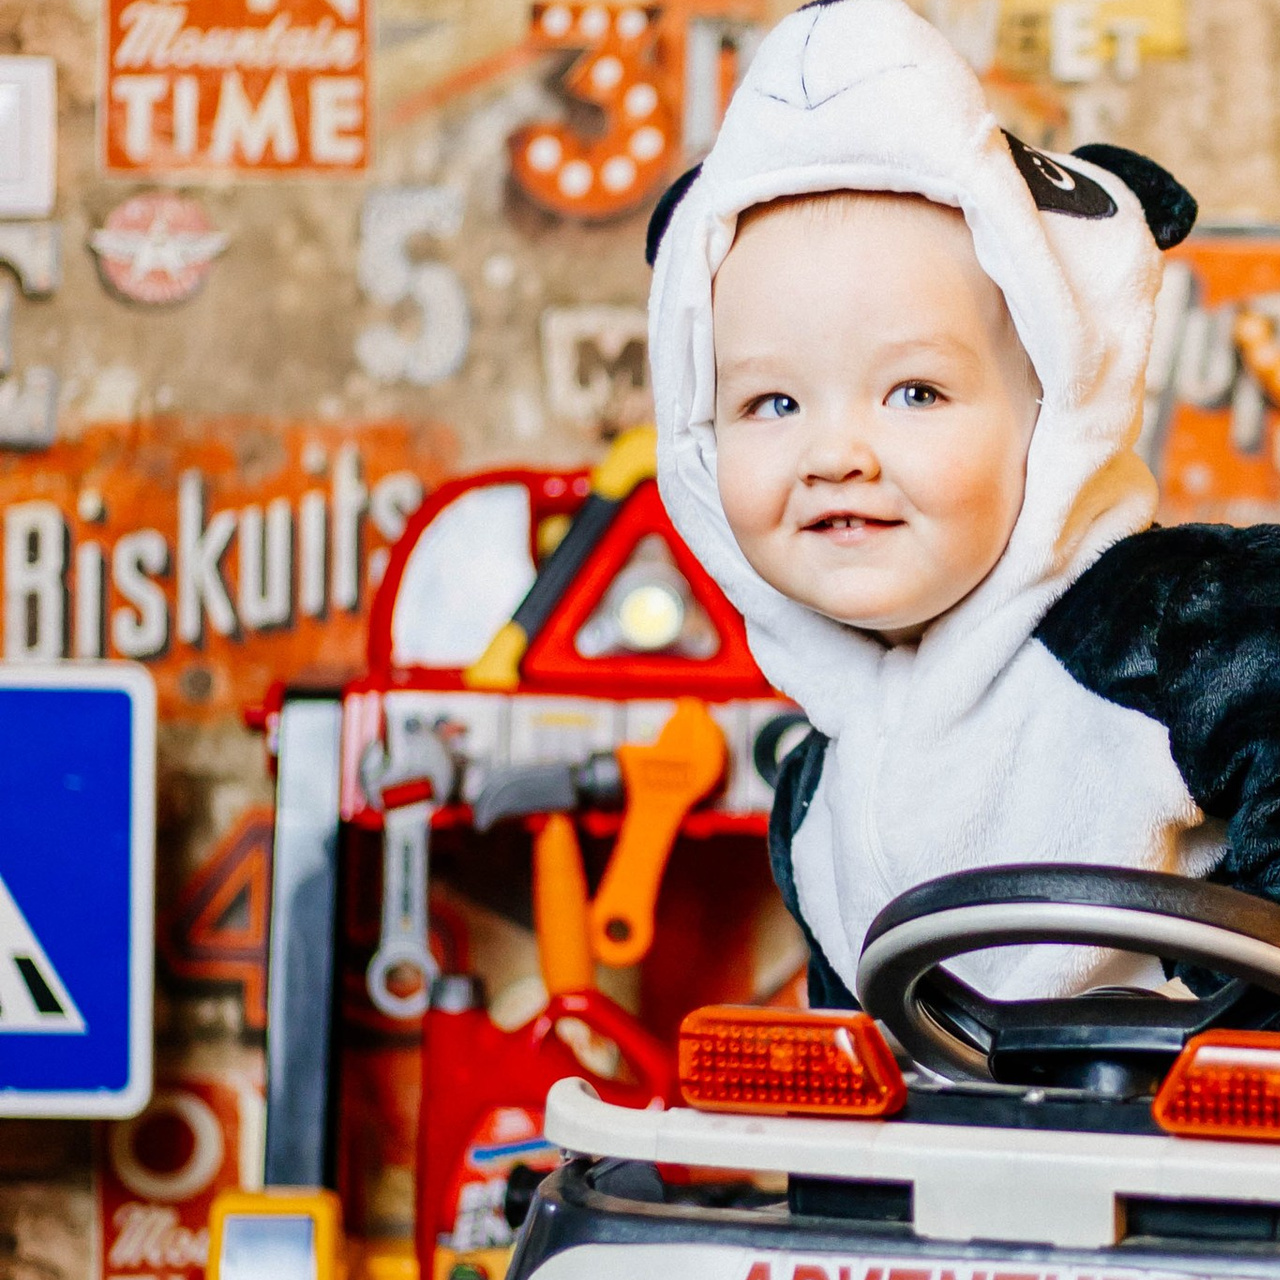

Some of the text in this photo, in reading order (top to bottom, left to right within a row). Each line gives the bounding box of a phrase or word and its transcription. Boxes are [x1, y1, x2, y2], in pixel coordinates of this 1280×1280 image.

[115, 0, 361, 72] Mountain
[113, 72, 365, 166] TIME
[354, 183, 471, 386] 5
